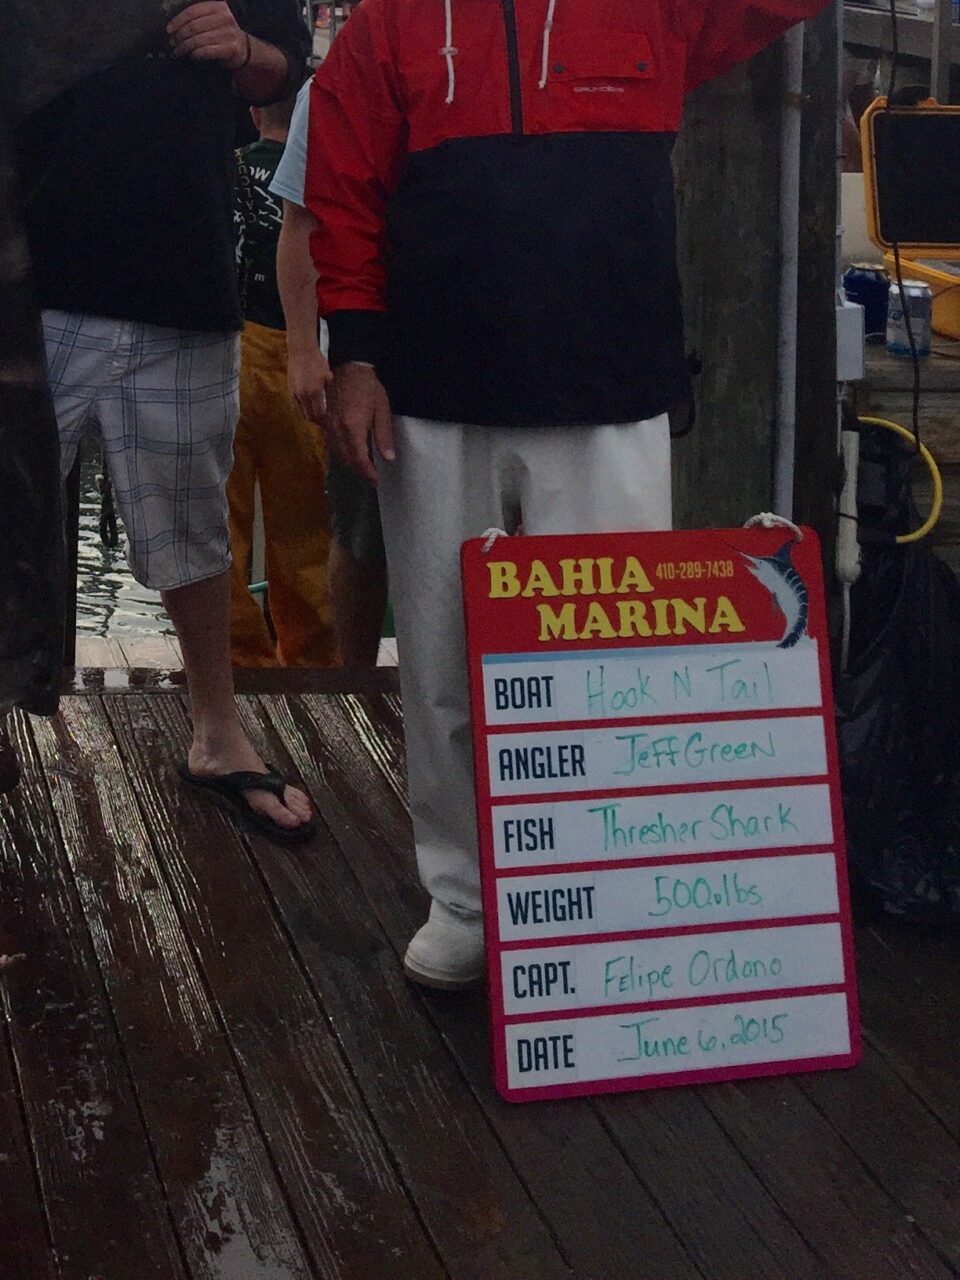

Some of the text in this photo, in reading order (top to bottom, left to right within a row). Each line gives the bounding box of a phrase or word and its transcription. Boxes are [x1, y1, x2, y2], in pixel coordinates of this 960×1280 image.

[486, 555, 735, 600] BAHIA 410-289-7438
[537, 595, 746, 642] MARINA
[494, 675, 554, 710] BOAT
[586, 658, 774, 716] Hook N Tail
[498, 744, 586, 782] ANGLER
[503, 816, 555, 853] FISH
[588, 803, 799, 852] Thresher Shark
[507, 885, 595, 926] WEIGHT
[512, 960, 576, 999] CAPT.
[517, 1033, 576, 1074] DATE
[617, 1016, 689, 1063] June
